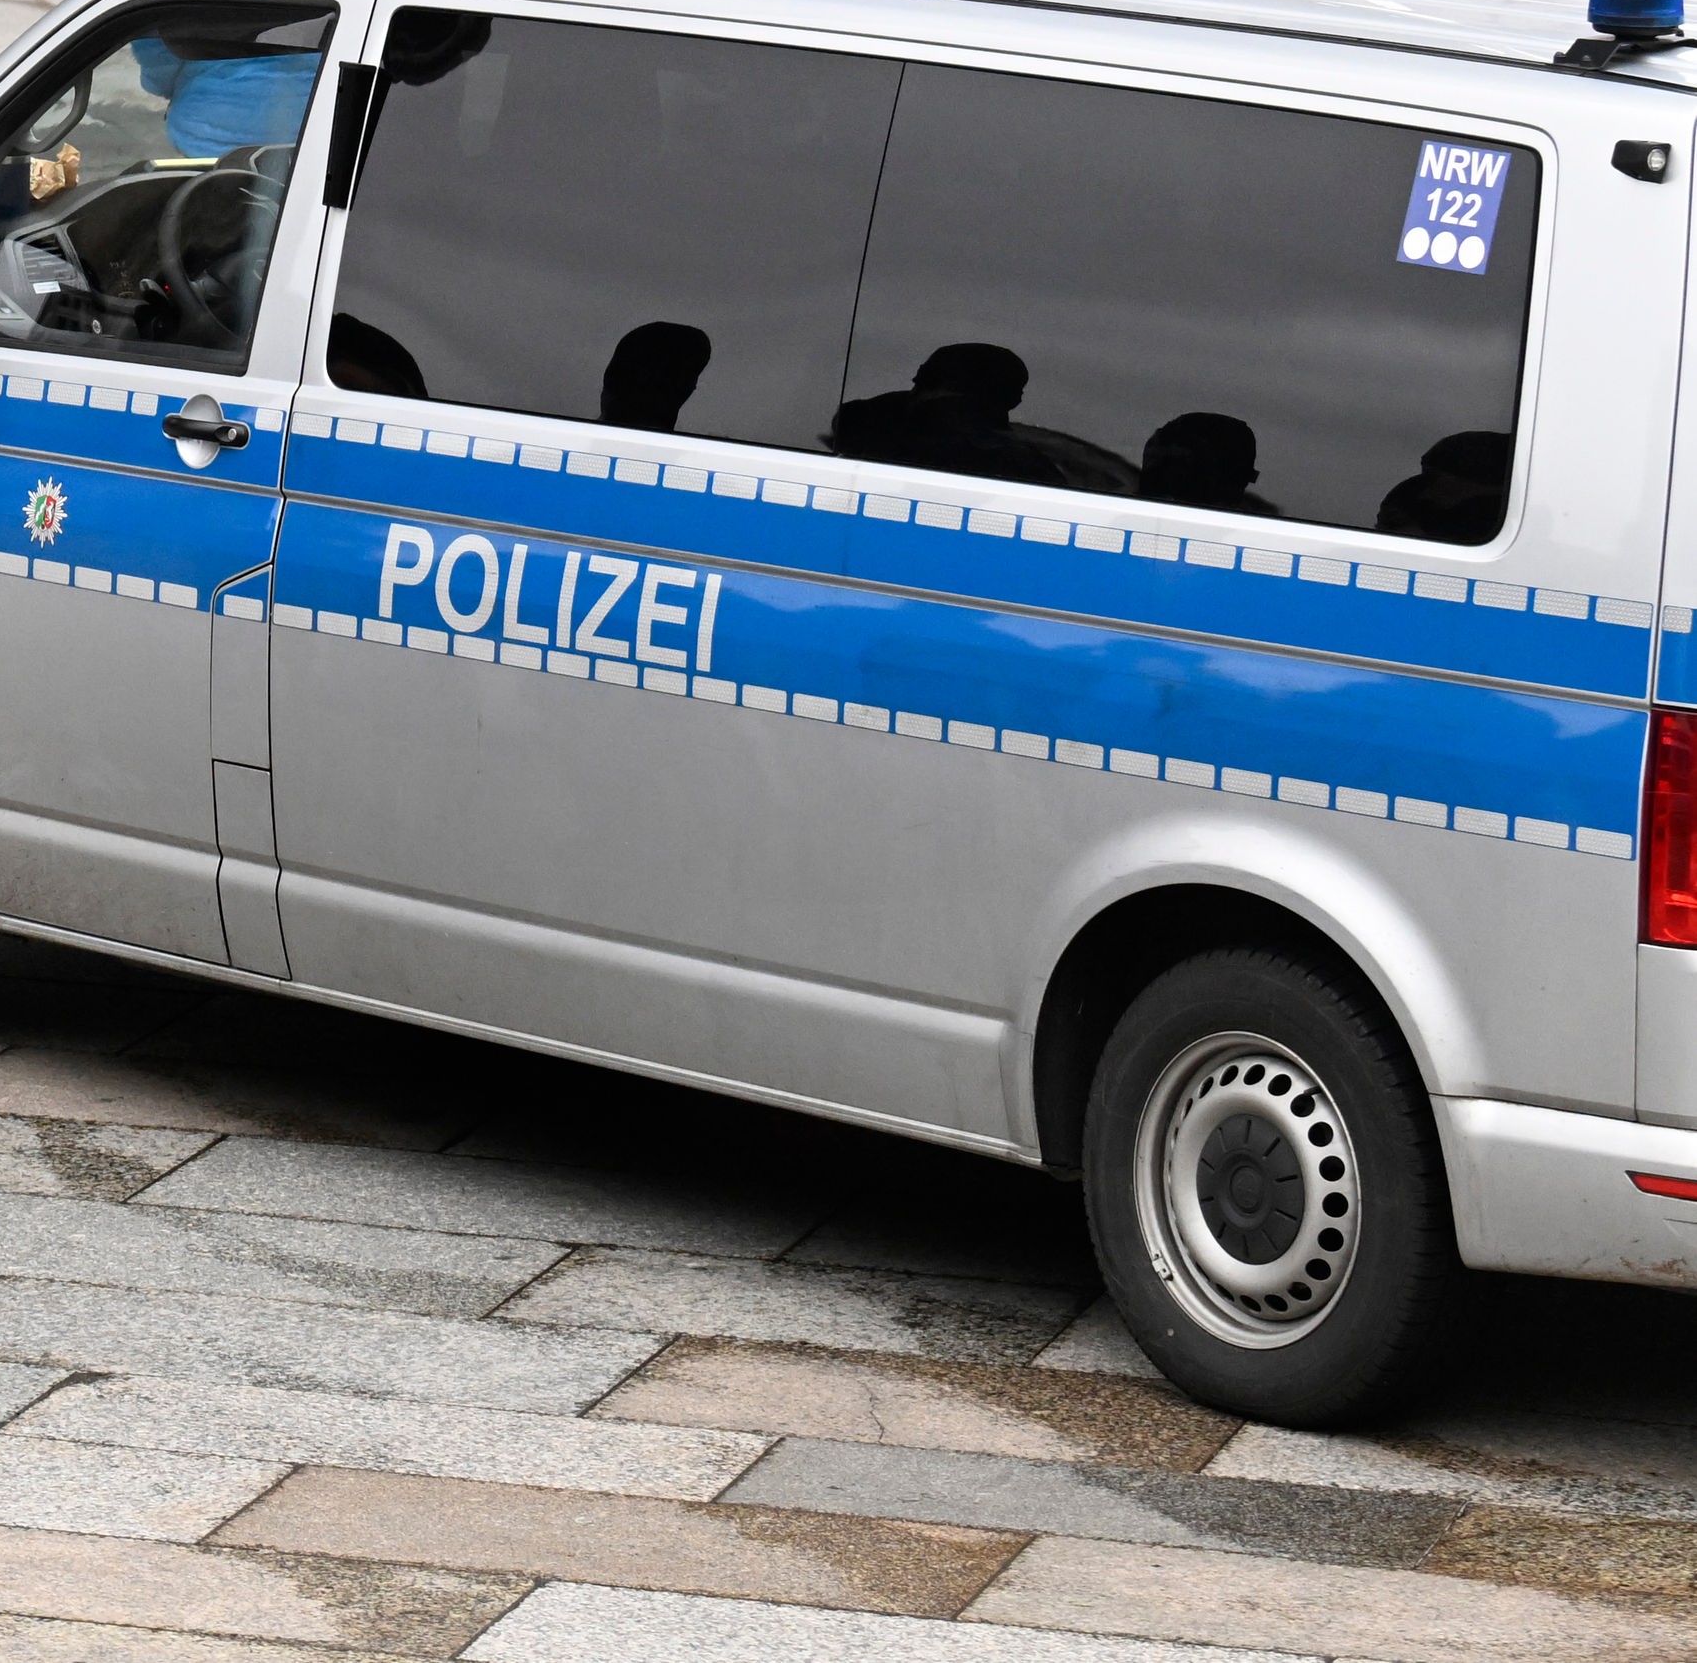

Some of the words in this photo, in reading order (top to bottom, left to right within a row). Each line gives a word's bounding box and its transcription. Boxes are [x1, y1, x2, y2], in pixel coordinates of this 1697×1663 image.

[1419, 144, 1506, 188] NRW
[1426, 187, 1482, 228] 122
[378, 522, 722, 673] POLIZEI
